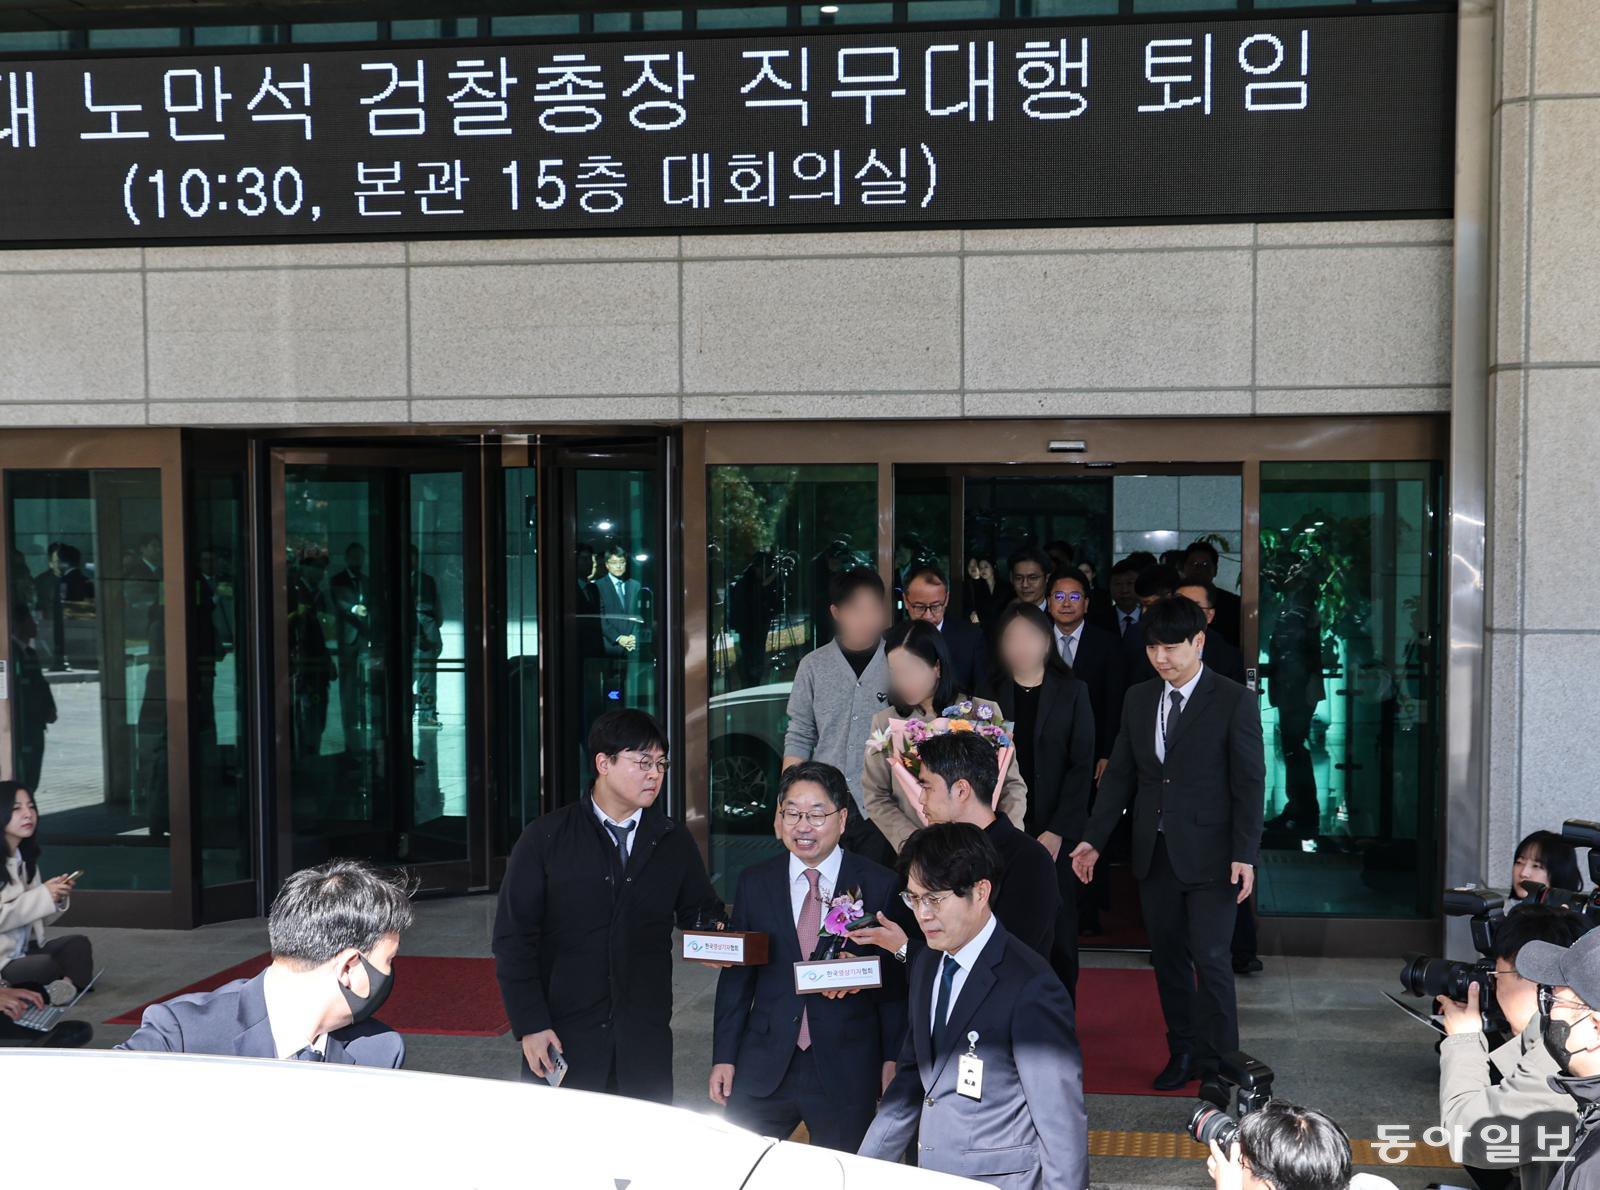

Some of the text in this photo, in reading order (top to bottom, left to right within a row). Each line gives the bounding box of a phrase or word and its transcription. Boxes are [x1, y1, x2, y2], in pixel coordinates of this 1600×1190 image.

[81, 64, 311, 141] 노만석
[360, 52, 694, 135] 검찰총장
[741, 38, 1087, 126] 직무대행
[1138, 30, 1307, 114] 퇴임
[124, 143, 936, 225] (10:30, 본관 15층 대회의실)
[705, 943, 739, 952] 한국영상기자협회
[826, 967, 873, 977] 한국영상기자협회
